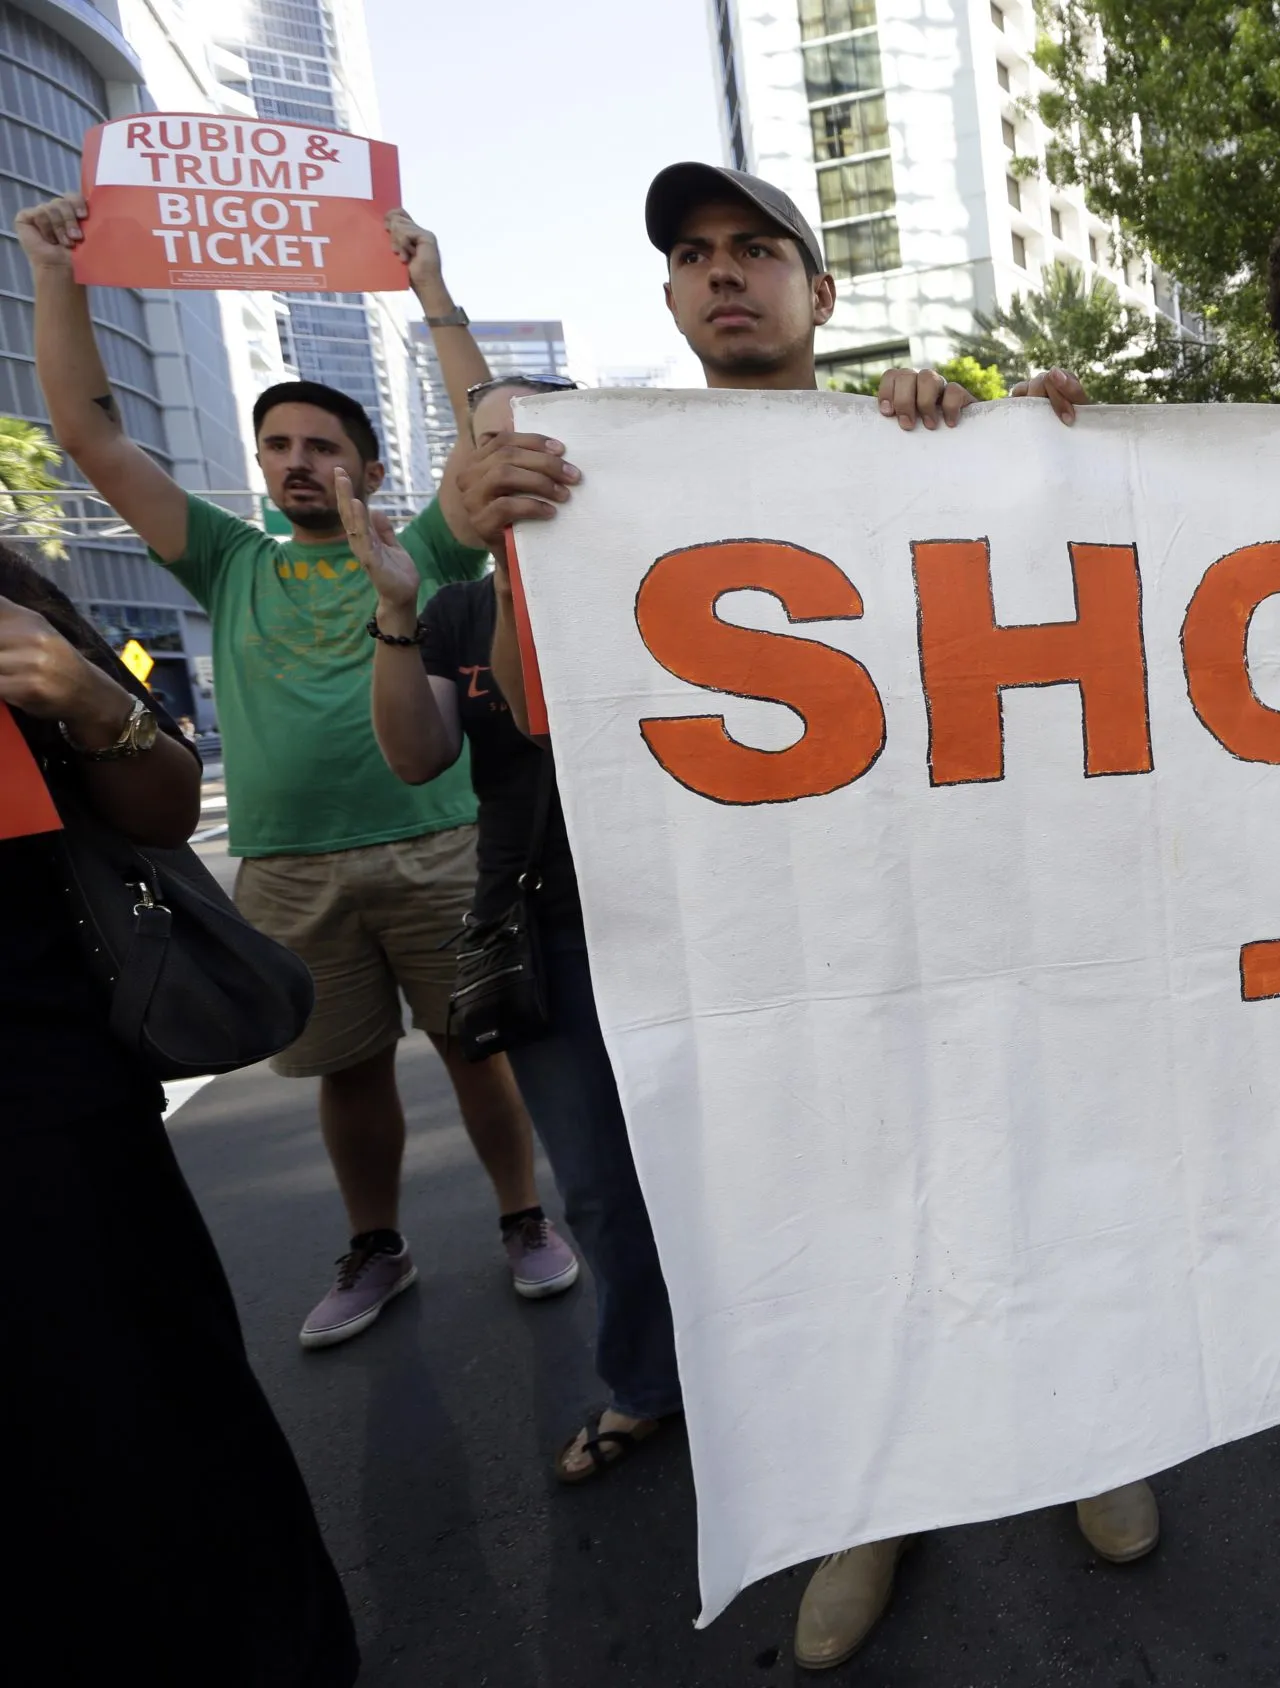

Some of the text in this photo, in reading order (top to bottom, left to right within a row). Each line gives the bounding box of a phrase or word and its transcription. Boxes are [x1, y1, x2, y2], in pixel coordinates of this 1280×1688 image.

[126, 120, 342, 163] RUBIO &
[140, 152, 324, 190] TRUMP
[157, 192, 320, 231] BIGOT
[152, 229, 331, 268] TICKET
